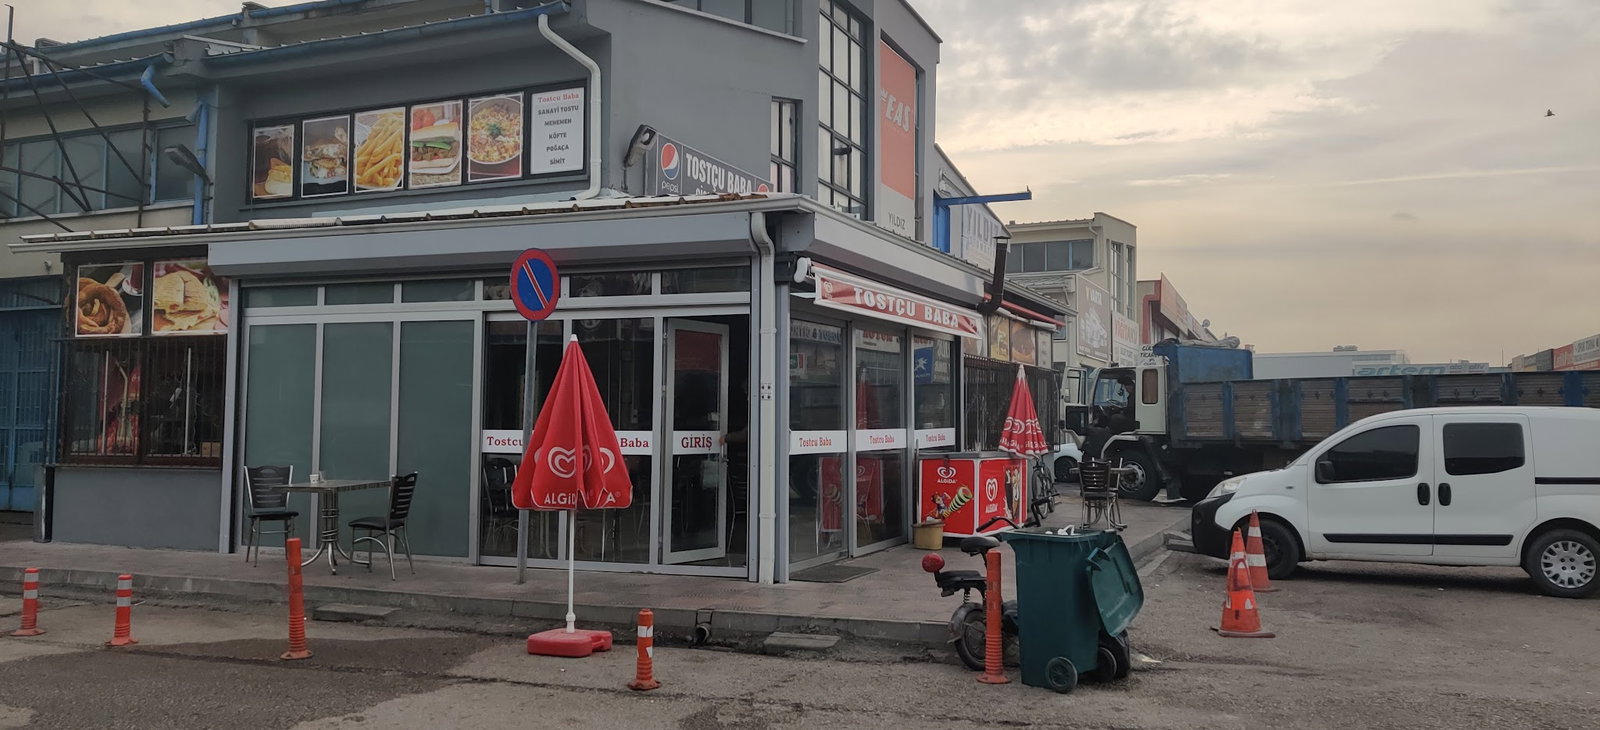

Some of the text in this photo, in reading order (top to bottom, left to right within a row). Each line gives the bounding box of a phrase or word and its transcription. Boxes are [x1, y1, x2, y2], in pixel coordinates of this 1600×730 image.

[538, 105, 579, 115] SANAYİ TOSTU
[886, 94, 911, 132] EAS
[544, 118, 572, 126] MENEMEN
[548, 132, 567, 140] KÖFTE
[546, 144, 569, 152] POĞAÇA
[686, 153, 753, 194] TOSTÇU BABA
[661, 180, 679, 194] pepsi
[888, 212, 906, 231] YILDIZ
[853, 287, 960, 328] TOSTÇU BABA
[620, 437, 650, 448] Baba
[681, 433, 713, 451] GİRİŞ
[819, 437, 832, 446] Baba
